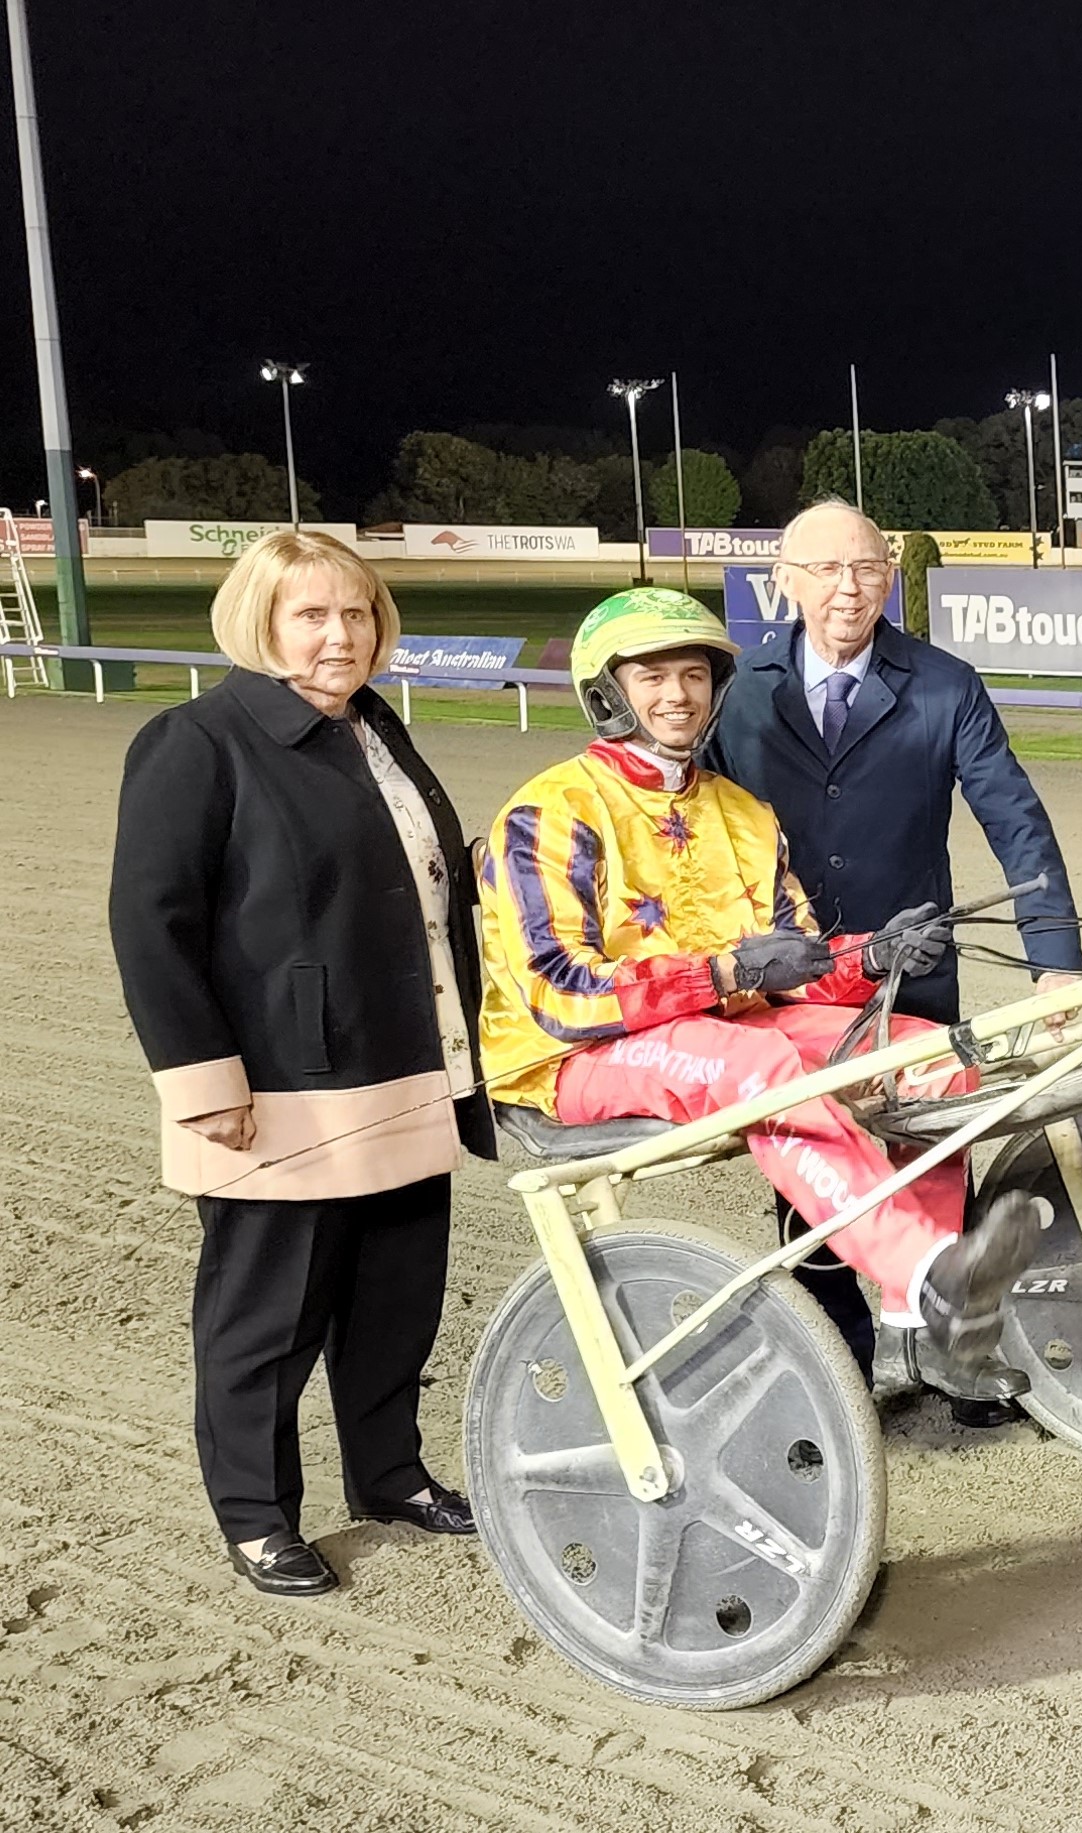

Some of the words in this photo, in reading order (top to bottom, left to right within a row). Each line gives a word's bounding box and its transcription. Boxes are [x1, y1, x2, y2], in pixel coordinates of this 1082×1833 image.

[685, 532, 781, 556] TABtouc
[430, 649, 507, 671] Australian
[1010, 1279, 1068, 1294] LZR
[734, 1520, 806, 1574] LZR
